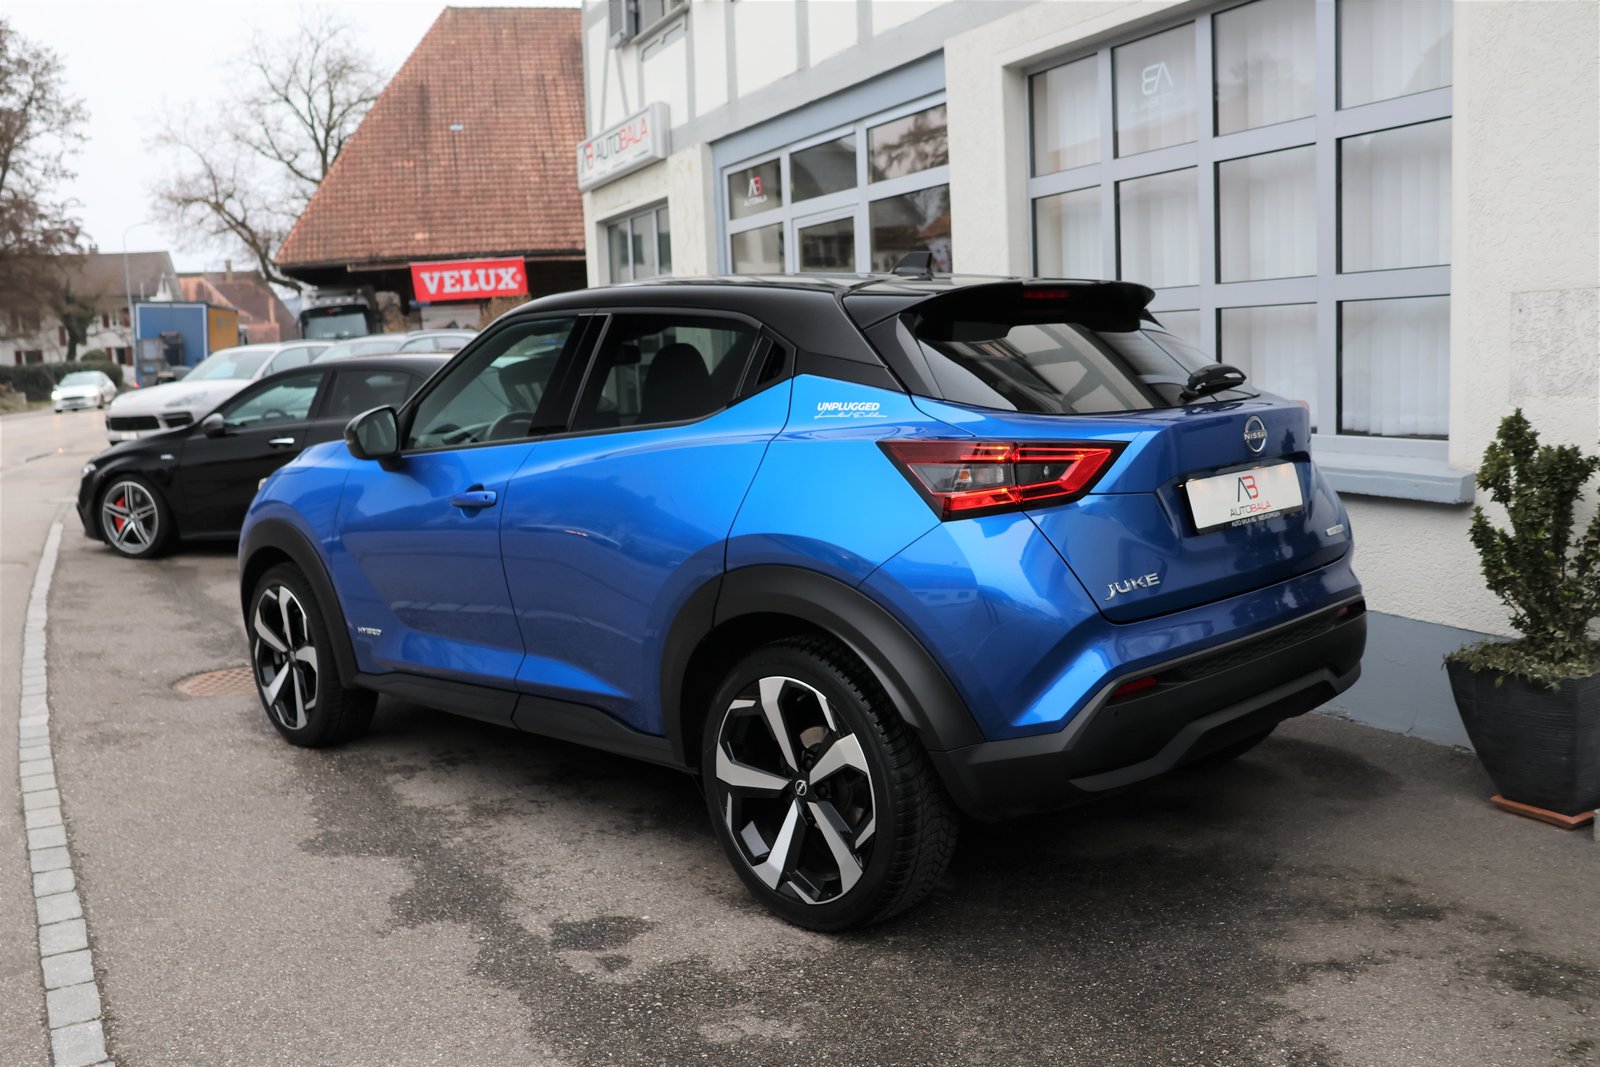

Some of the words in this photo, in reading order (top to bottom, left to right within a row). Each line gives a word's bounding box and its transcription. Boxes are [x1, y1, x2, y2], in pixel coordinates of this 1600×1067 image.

[596, 117, 649, 160] AUTOBALA
[420, 266, 519, 295] VELUX
[816, 401, 881, 411] UNPLUGGED
[1243, 430, 1267, 441] NISSA
[1230, 500, 1272, 517] AUTOBALA
[1104, 572, 1160, 601] JUKE
